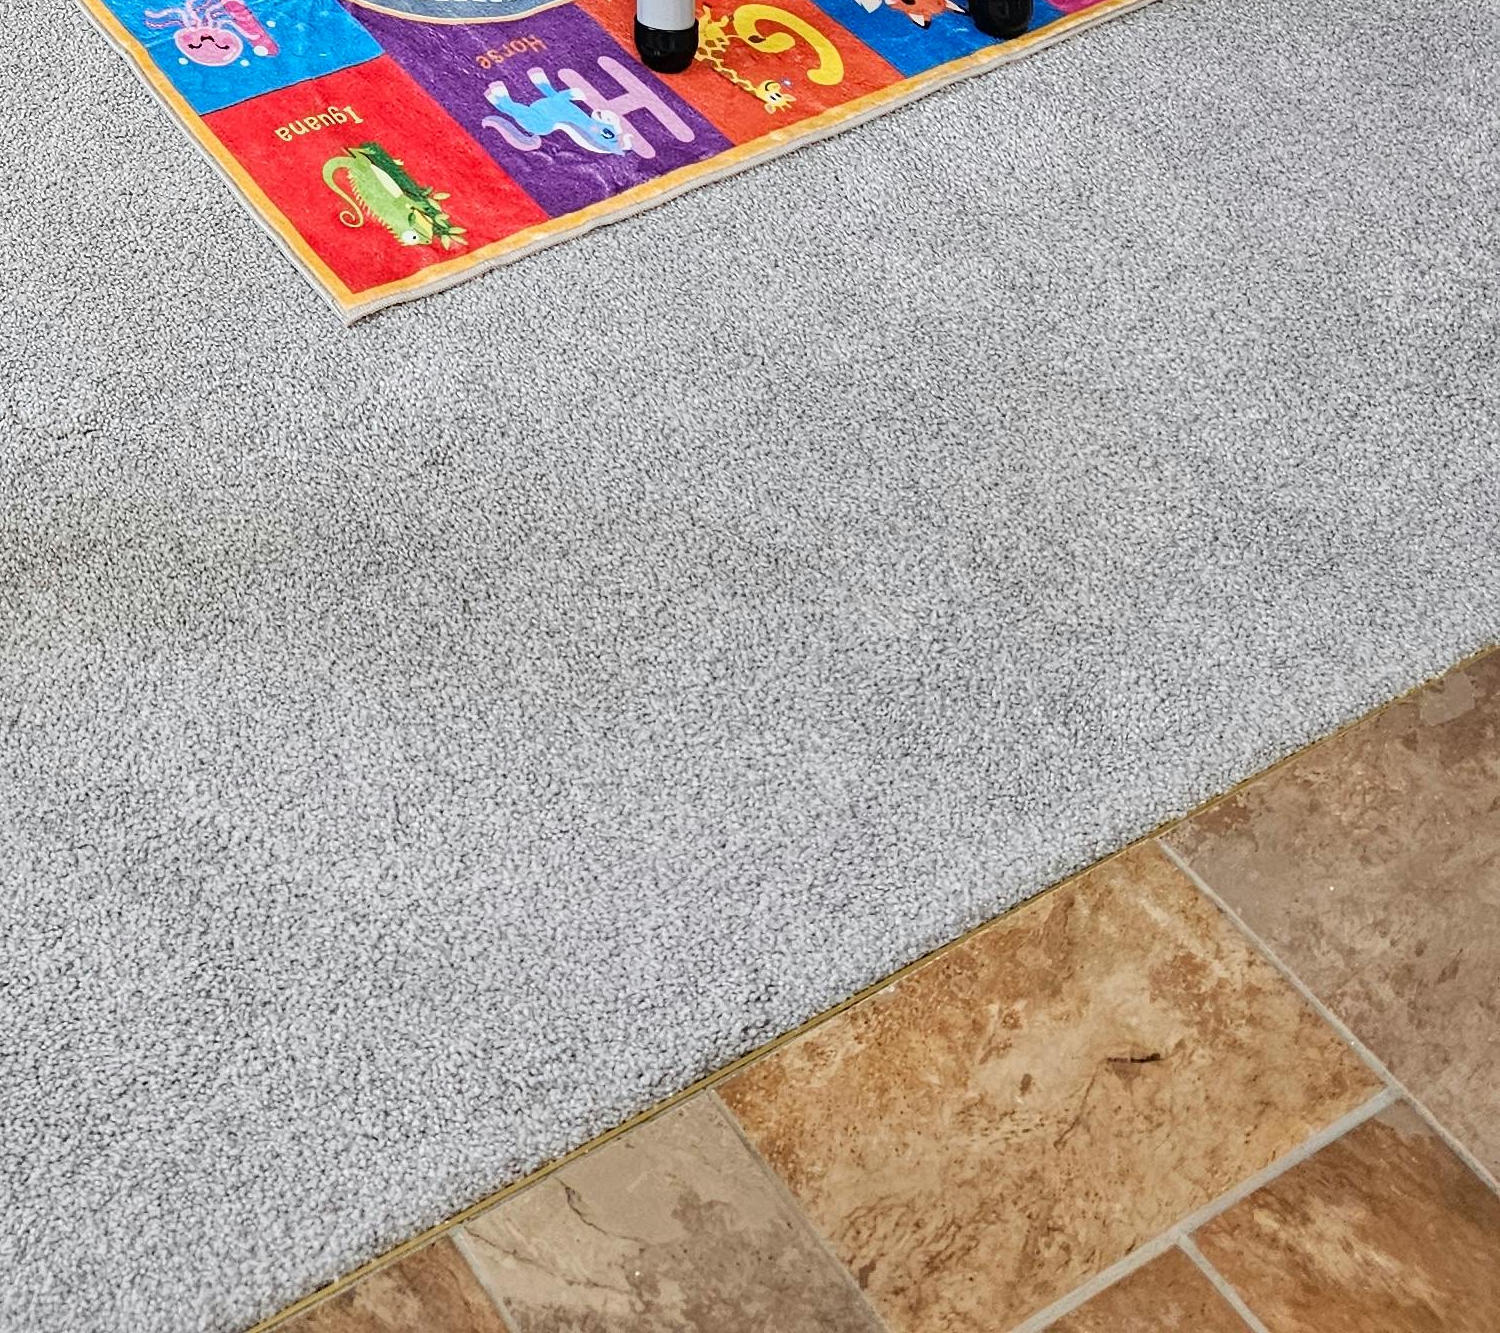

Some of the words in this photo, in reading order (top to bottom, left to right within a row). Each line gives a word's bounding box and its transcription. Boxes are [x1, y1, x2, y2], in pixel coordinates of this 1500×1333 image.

[475, 33, 549, 70] Horse
[274, 104, 364, 143] Iguana
[556, 55, 696, 159] H
